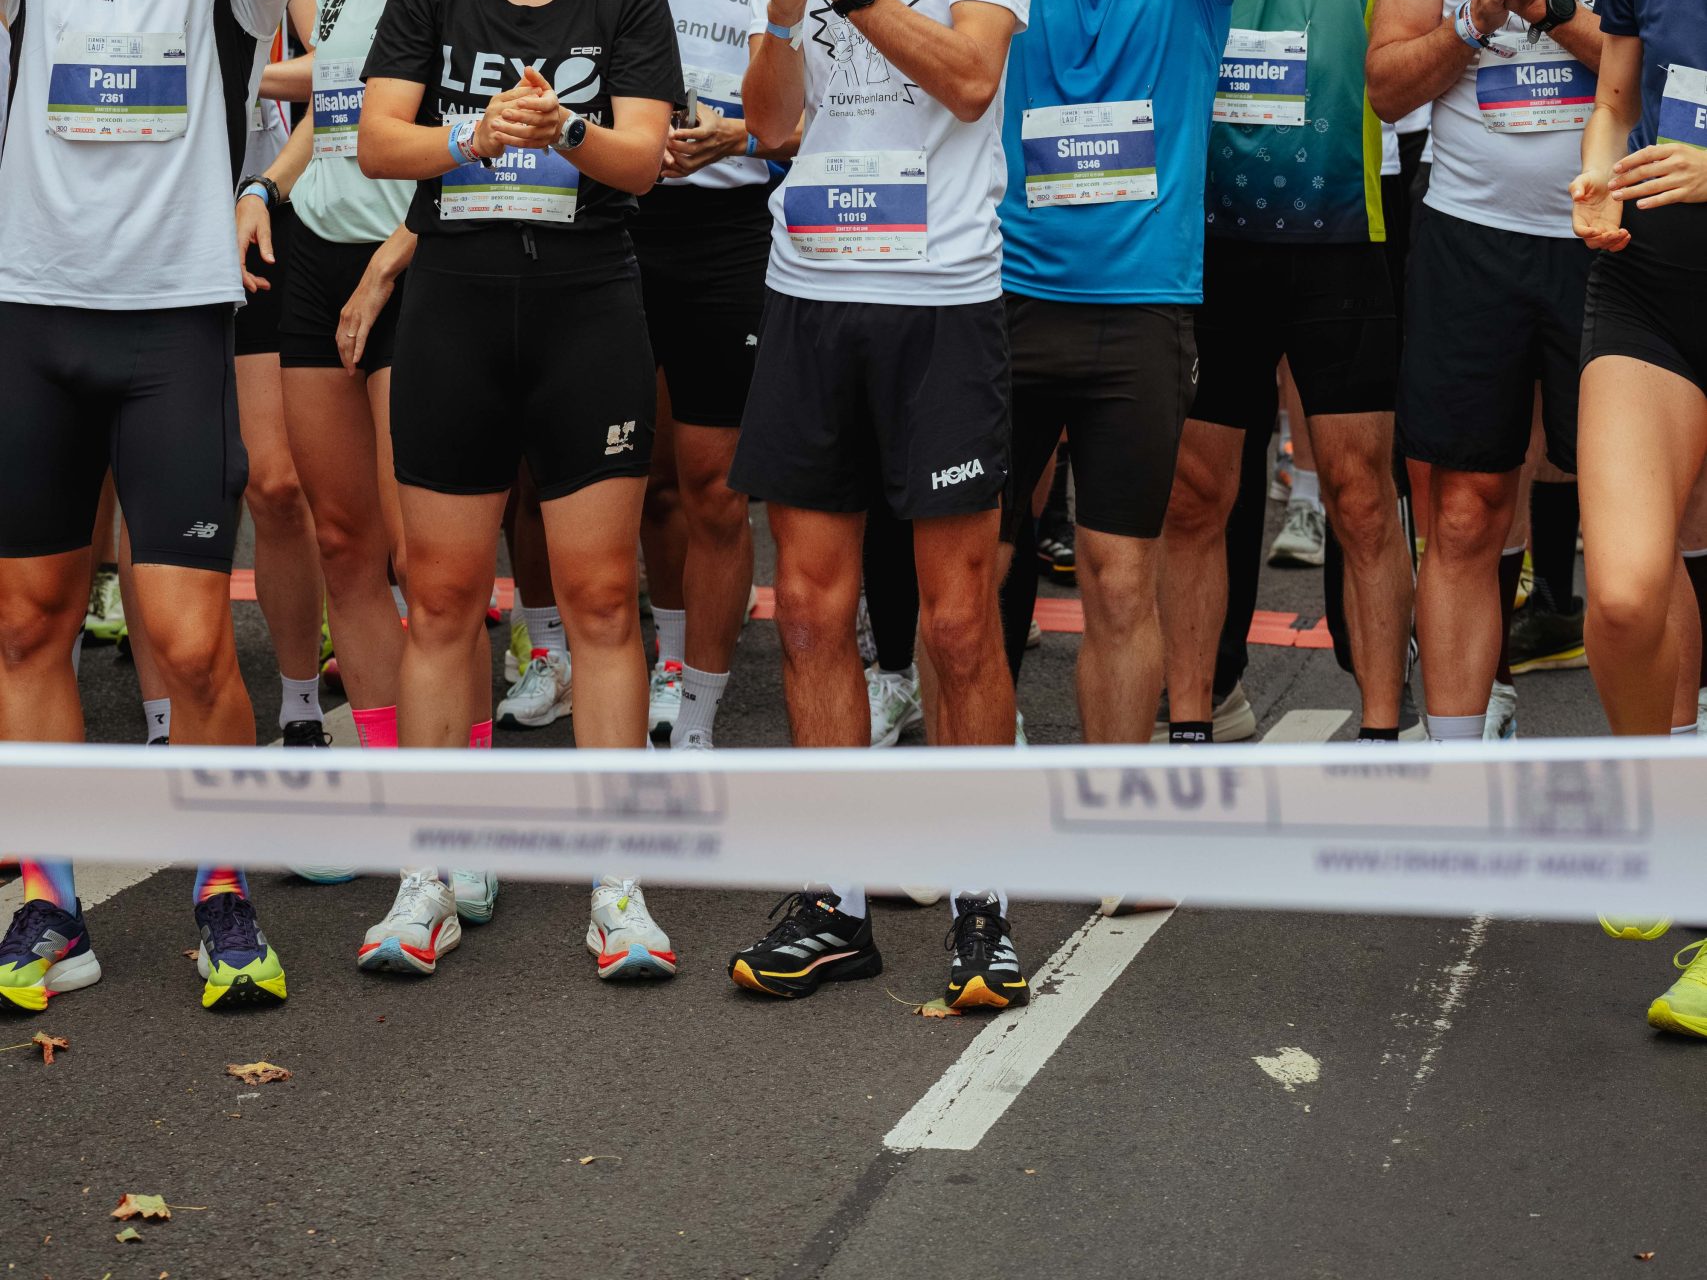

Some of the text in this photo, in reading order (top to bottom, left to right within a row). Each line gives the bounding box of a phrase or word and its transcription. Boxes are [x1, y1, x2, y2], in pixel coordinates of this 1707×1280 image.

[88, 43, 105, 52] LAUF
[570, 46, 602, 56] cep
[440, 44, 547, 96] LEX
[1516, 65, 1573, 85] Klaus
[89, 67, 137, 89] Paul
[1229, 81, 1250, 91] 1380
[1531, 87, 1559, 97] 11001
[100, 93, 124, 103] 7361
[314, 90, 365, 113] Elisabet
[331, 113, 349, 124] 7365
[1057, 137, 1120, 158] Simon
[480, 148, 537, 169] aria
[1077, 159, 1101, 169] 5346
[826, 164, 843, 172] LAUF
[494, 172, 517, 182] 7360
[827, 187, 877, 209] Felix
[838, 212, 867, 222] 11019
[931, 458, 985, 490] HOKA
[1172, 731, 1206, 742] cep
[1077, 765, 1246, 809] LAUF
